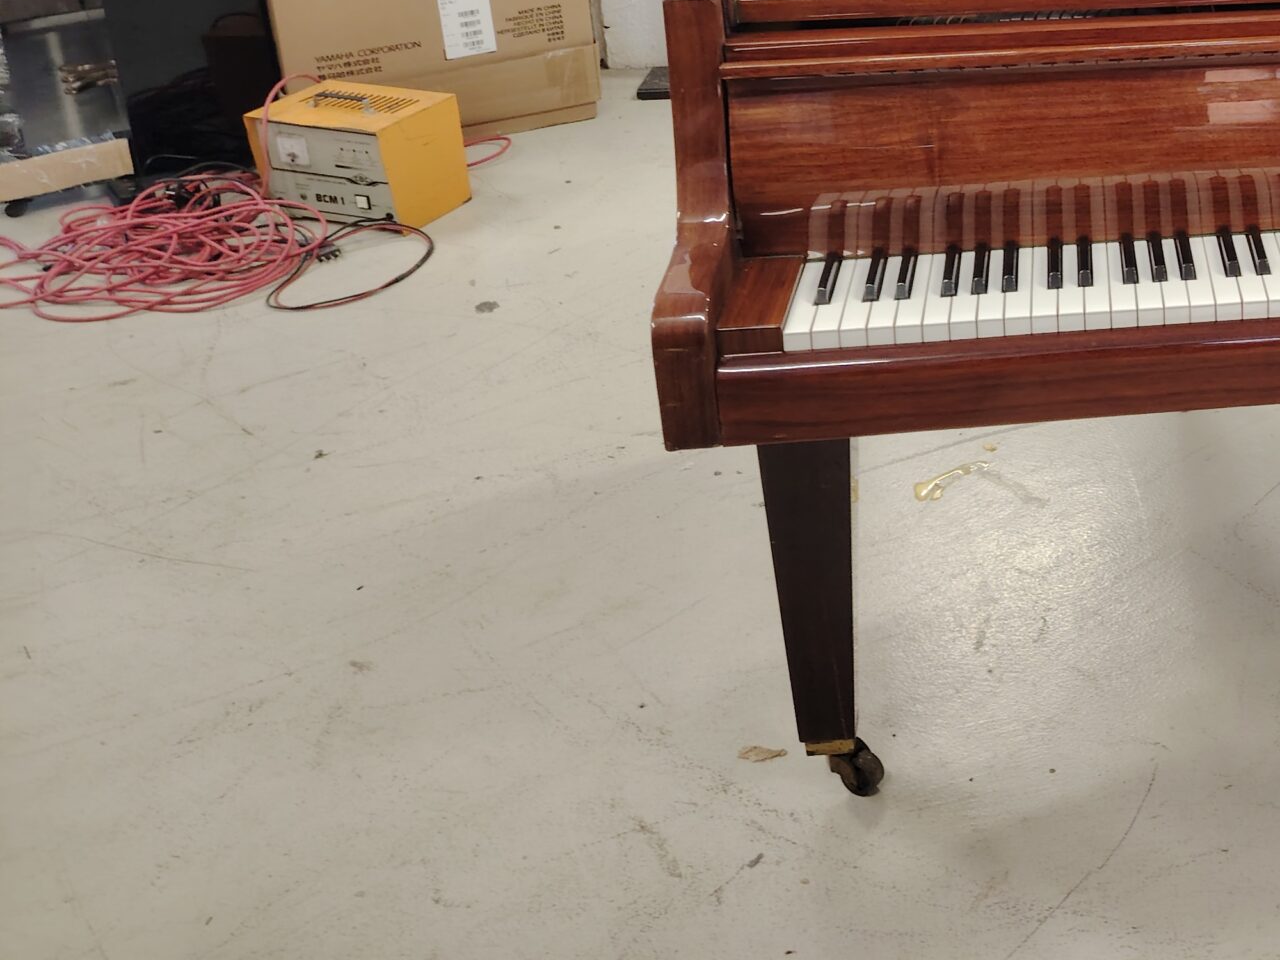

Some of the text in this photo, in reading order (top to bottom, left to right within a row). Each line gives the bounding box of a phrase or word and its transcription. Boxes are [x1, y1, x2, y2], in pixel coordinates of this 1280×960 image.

[315, 41, 422, 63] YAMAHA CORPORATION
[315, 193, 338, 204] BCM
